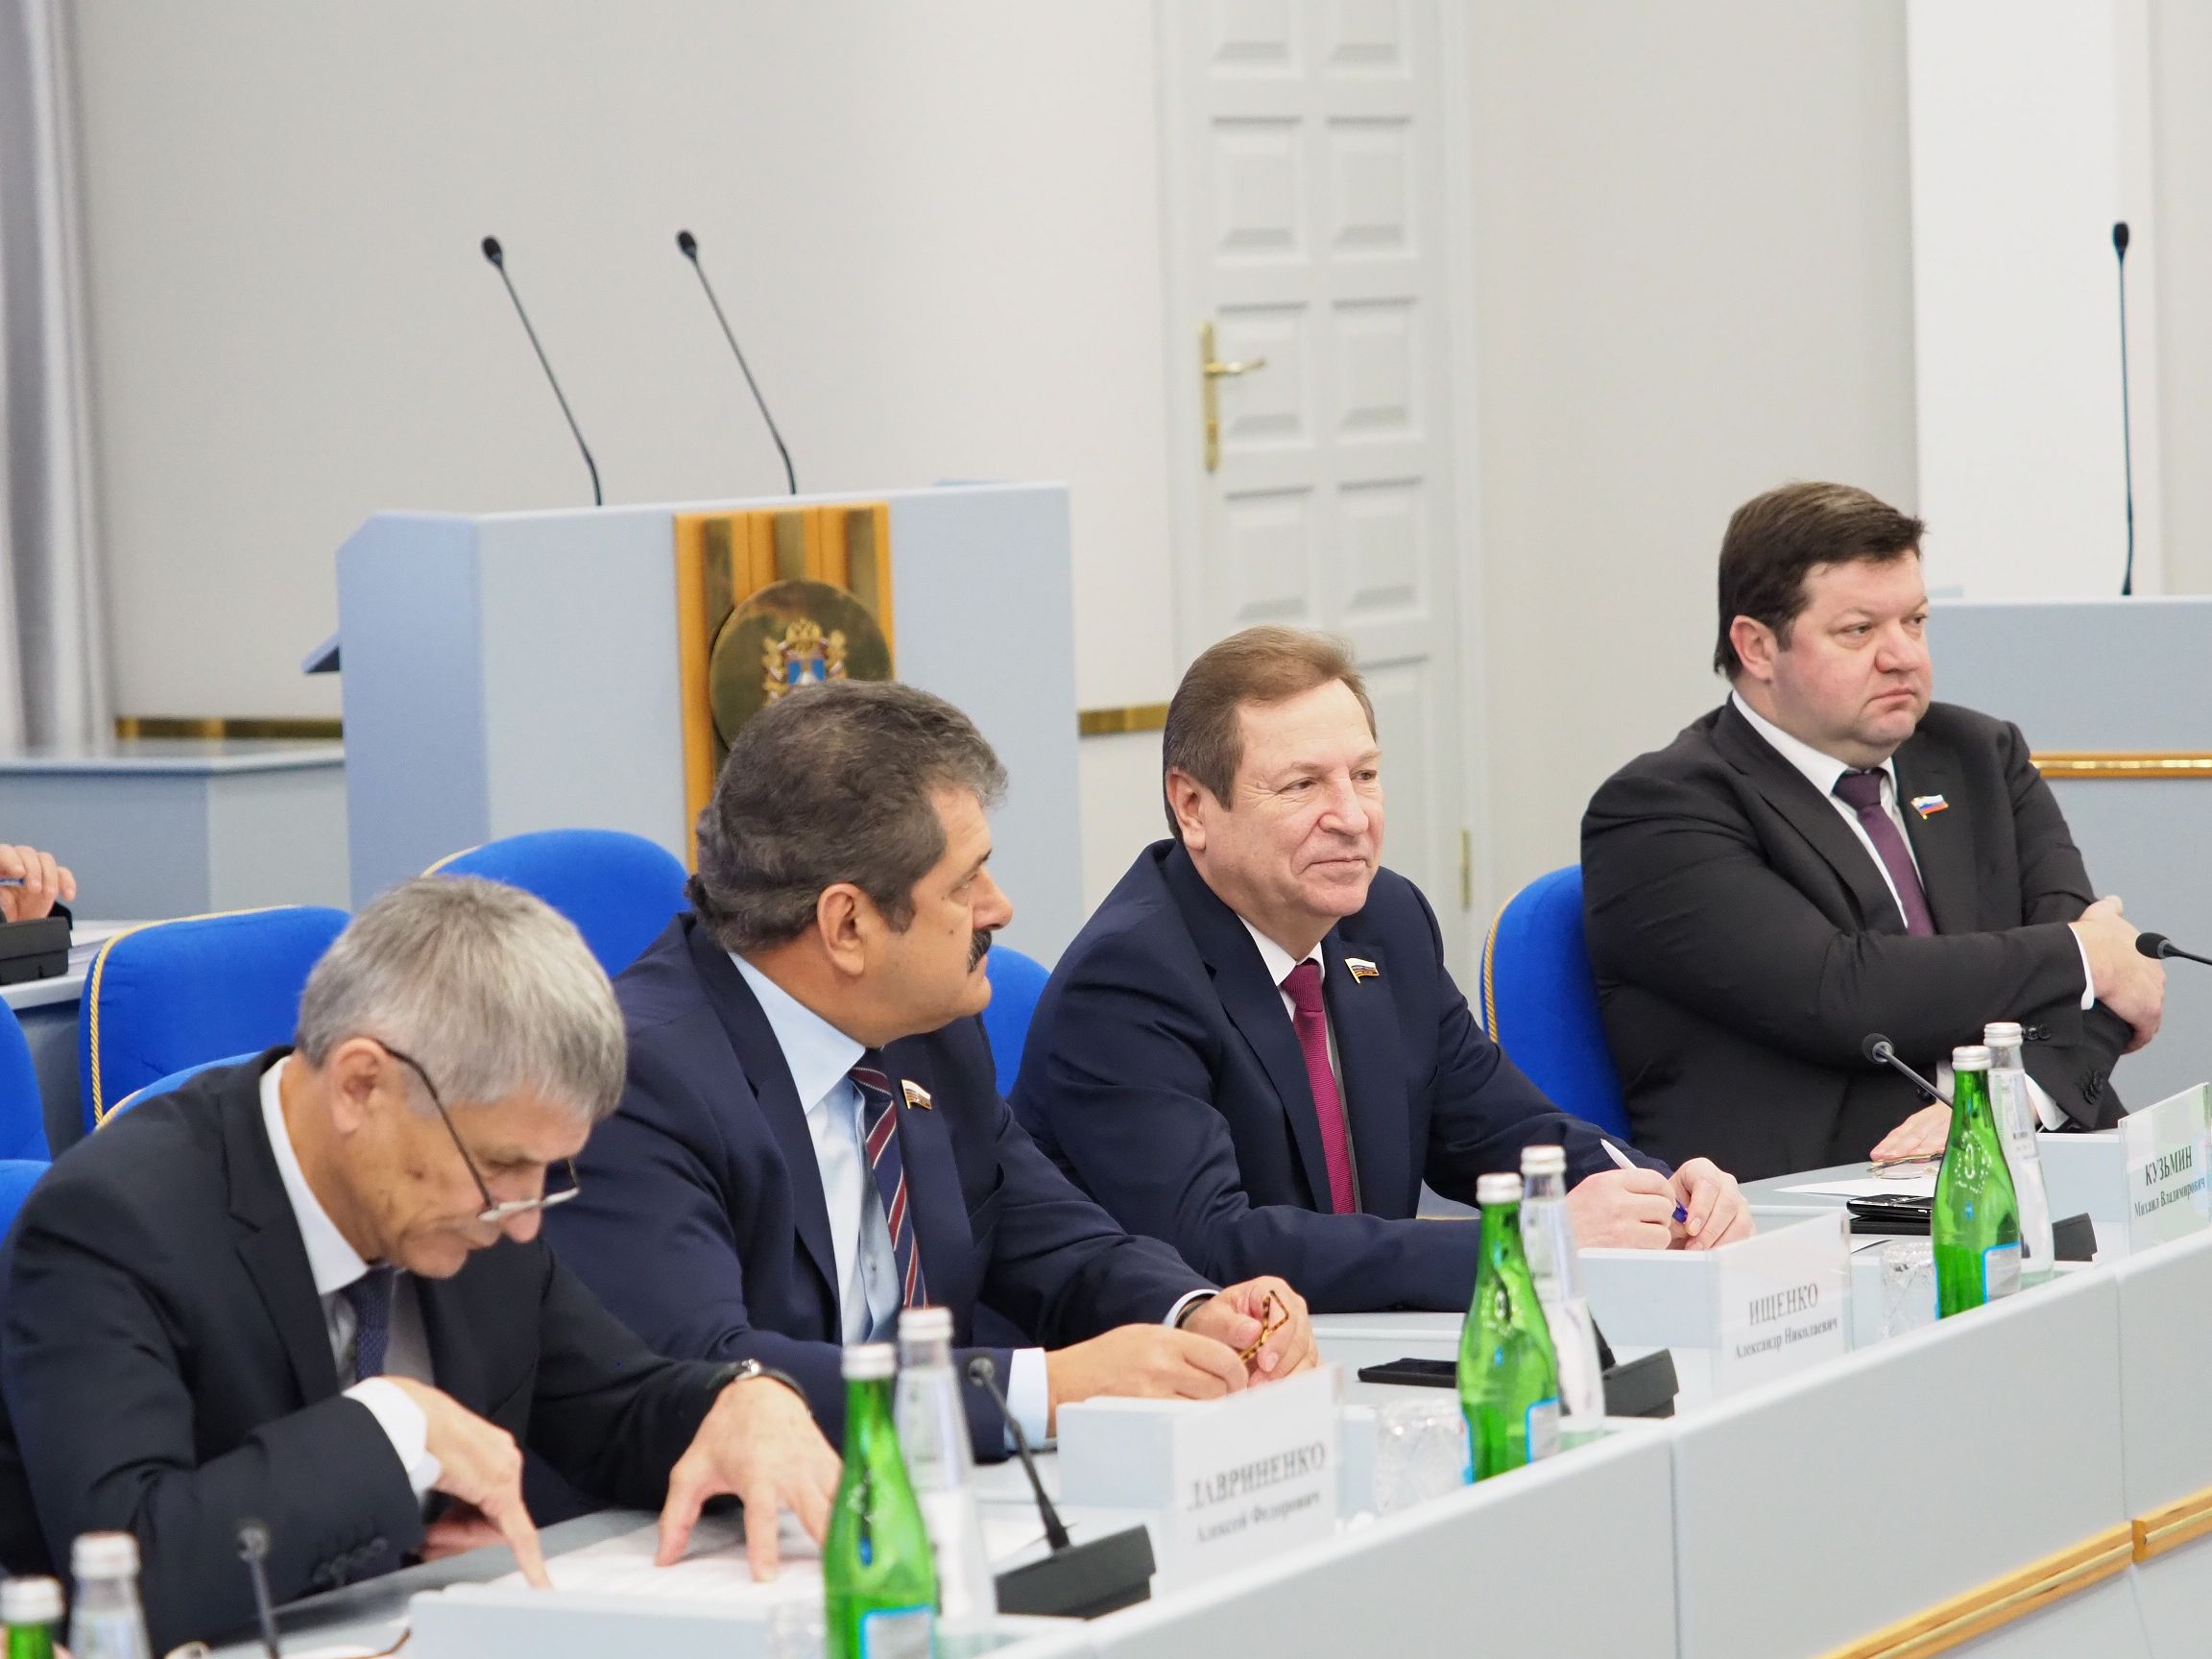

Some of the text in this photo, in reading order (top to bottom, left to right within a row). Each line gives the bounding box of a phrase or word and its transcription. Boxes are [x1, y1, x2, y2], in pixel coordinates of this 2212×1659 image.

[2146, 1146, 2192, 1186] КУЗЬМИН
[2135, 1178, 2204, 1217] Михаил Владимирович
[1749, 1283, 1817, 1325] ИЩЕНКО
[1736, 1318, 1837, 1358] Александр Николаевич
